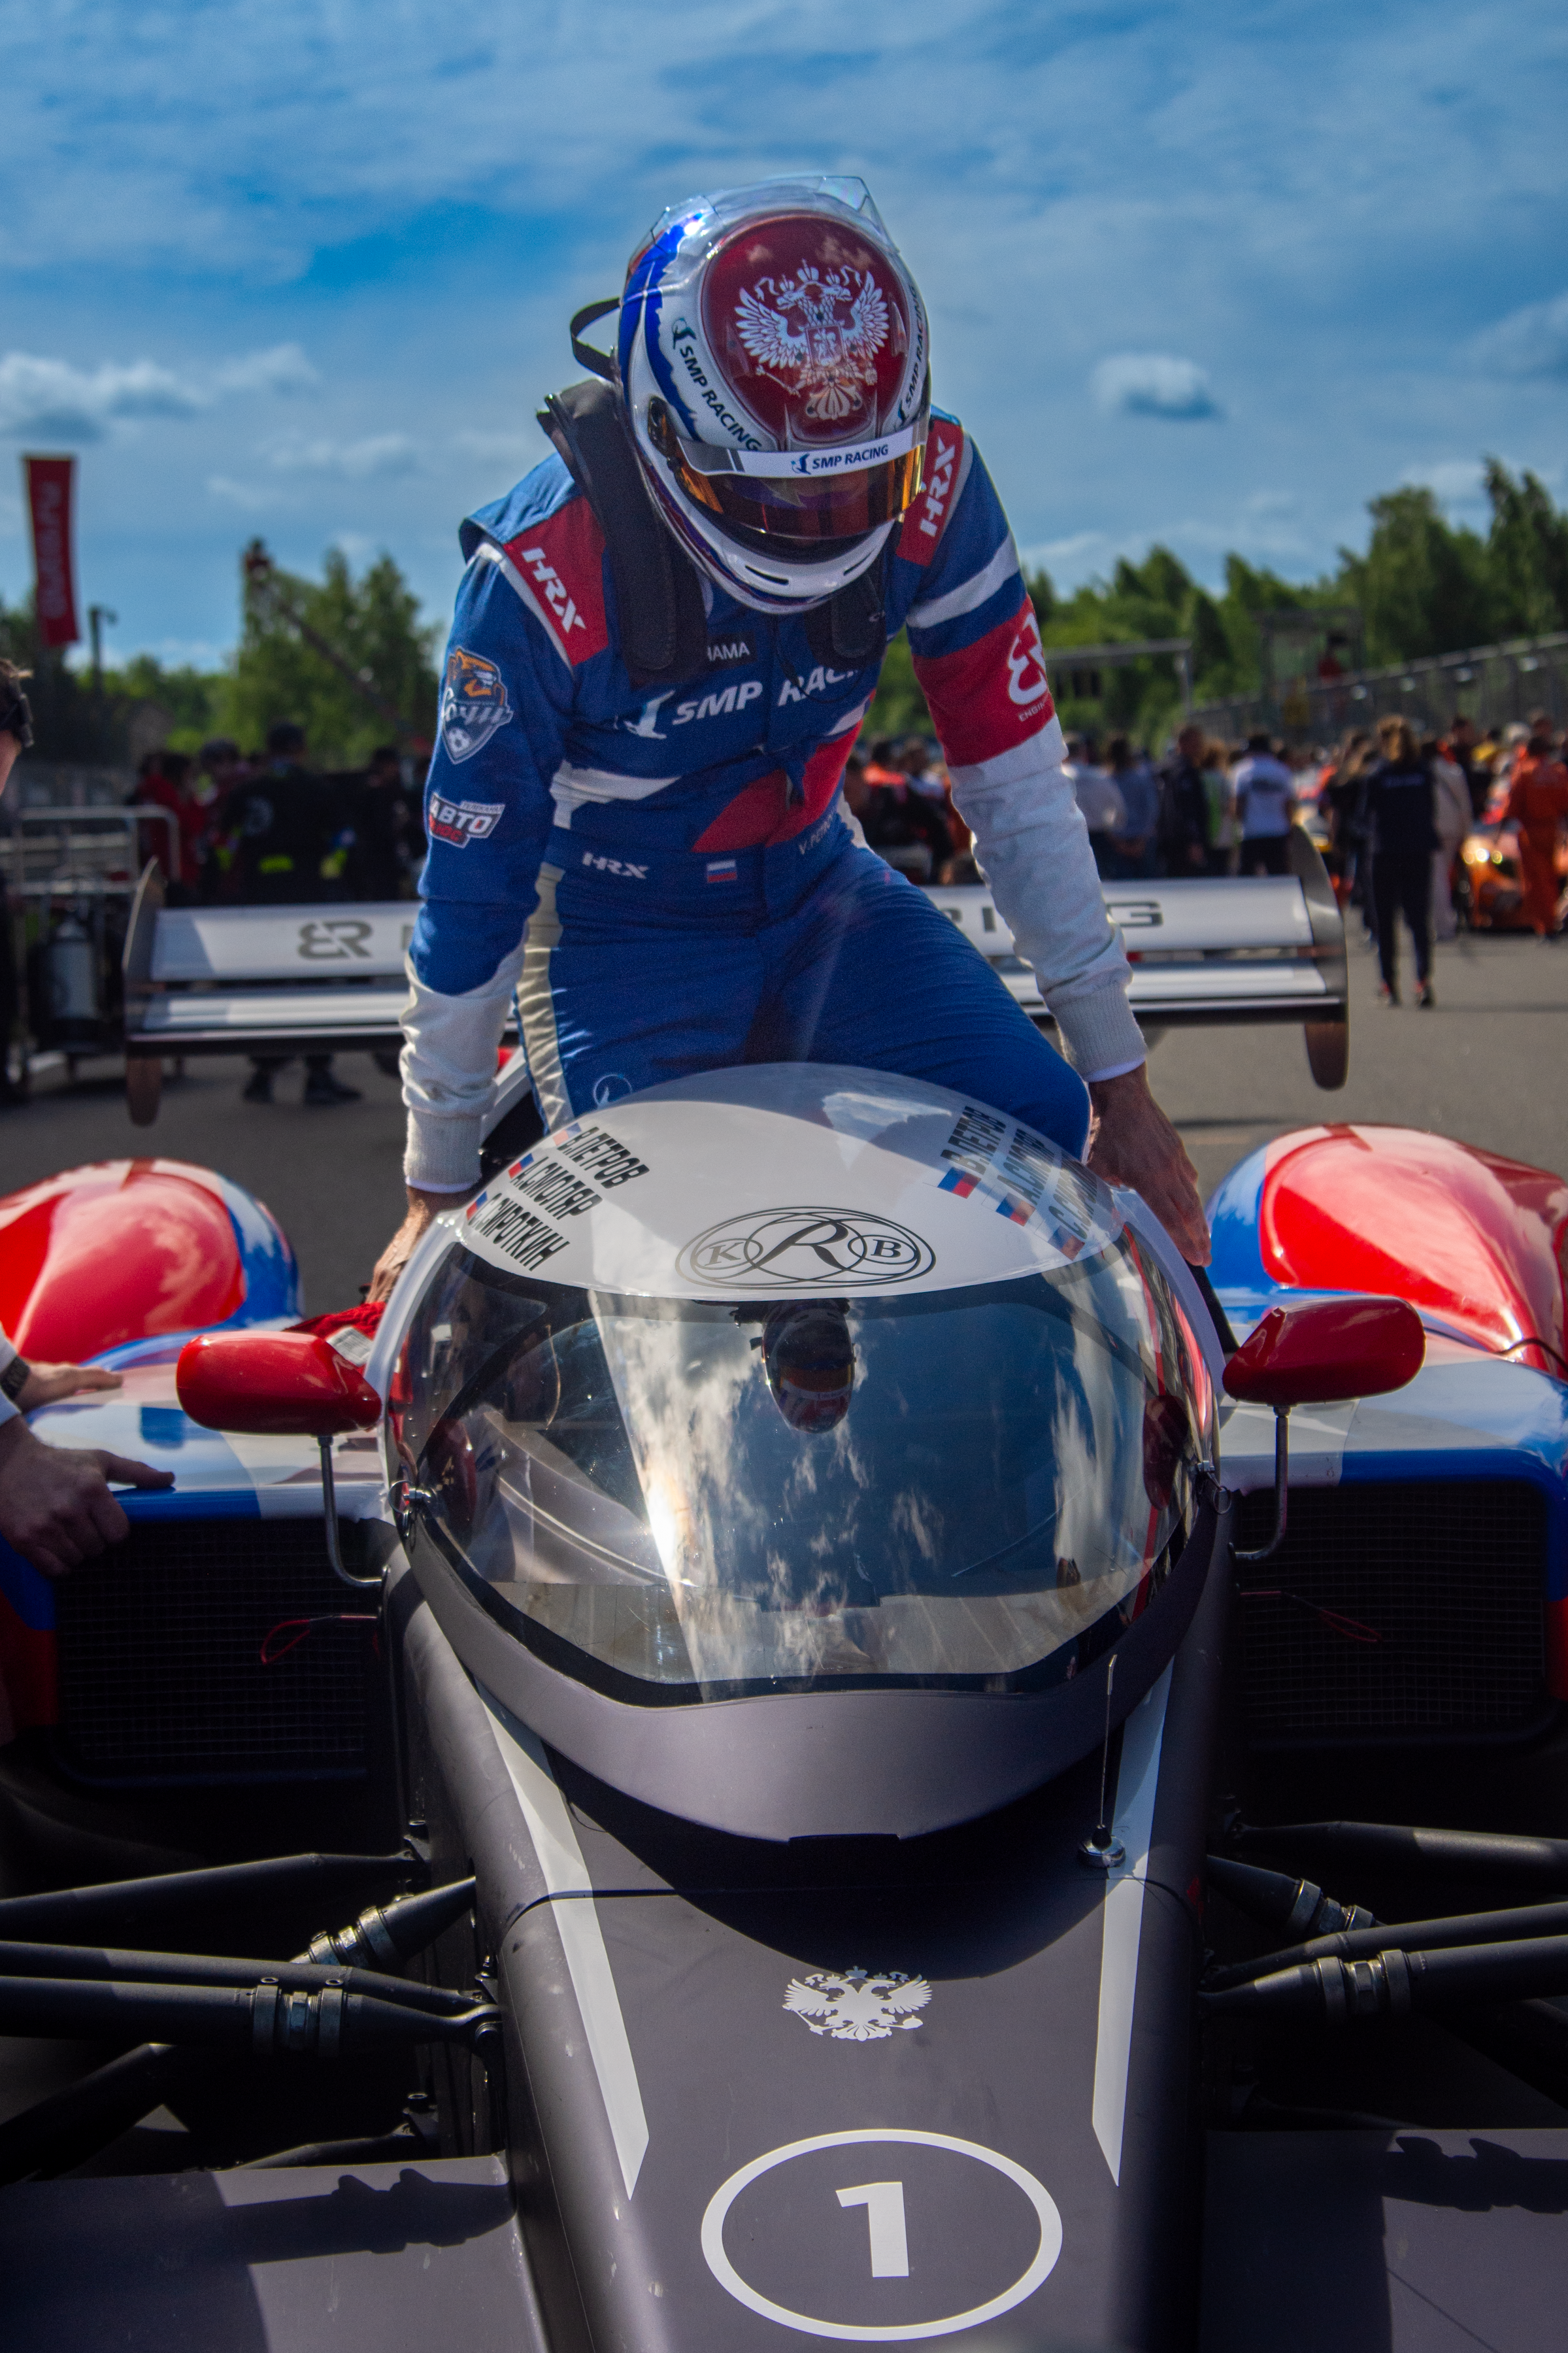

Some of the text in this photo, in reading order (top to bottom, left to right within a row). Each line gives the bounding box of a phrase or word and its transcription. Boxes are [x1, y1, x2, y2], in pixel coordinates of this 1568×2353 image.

[680, 345, 762, 451] SMP RACING
[905, 362, 919, 407] SMP
[812, 444, 889, 469] SMP RACING
[920, 435, 956, 537] HRX
[521, 547, 587, 634] HRX
[672, 681, 763, 725] SMP
[582, 851, 649, 879] HRX
[510, 1156, 603, 1221] А.СМОЛЯР
[557, 1126, 650, 1189] В.ПЕТРОВ
[835, 2182, 910, 2278] 1
